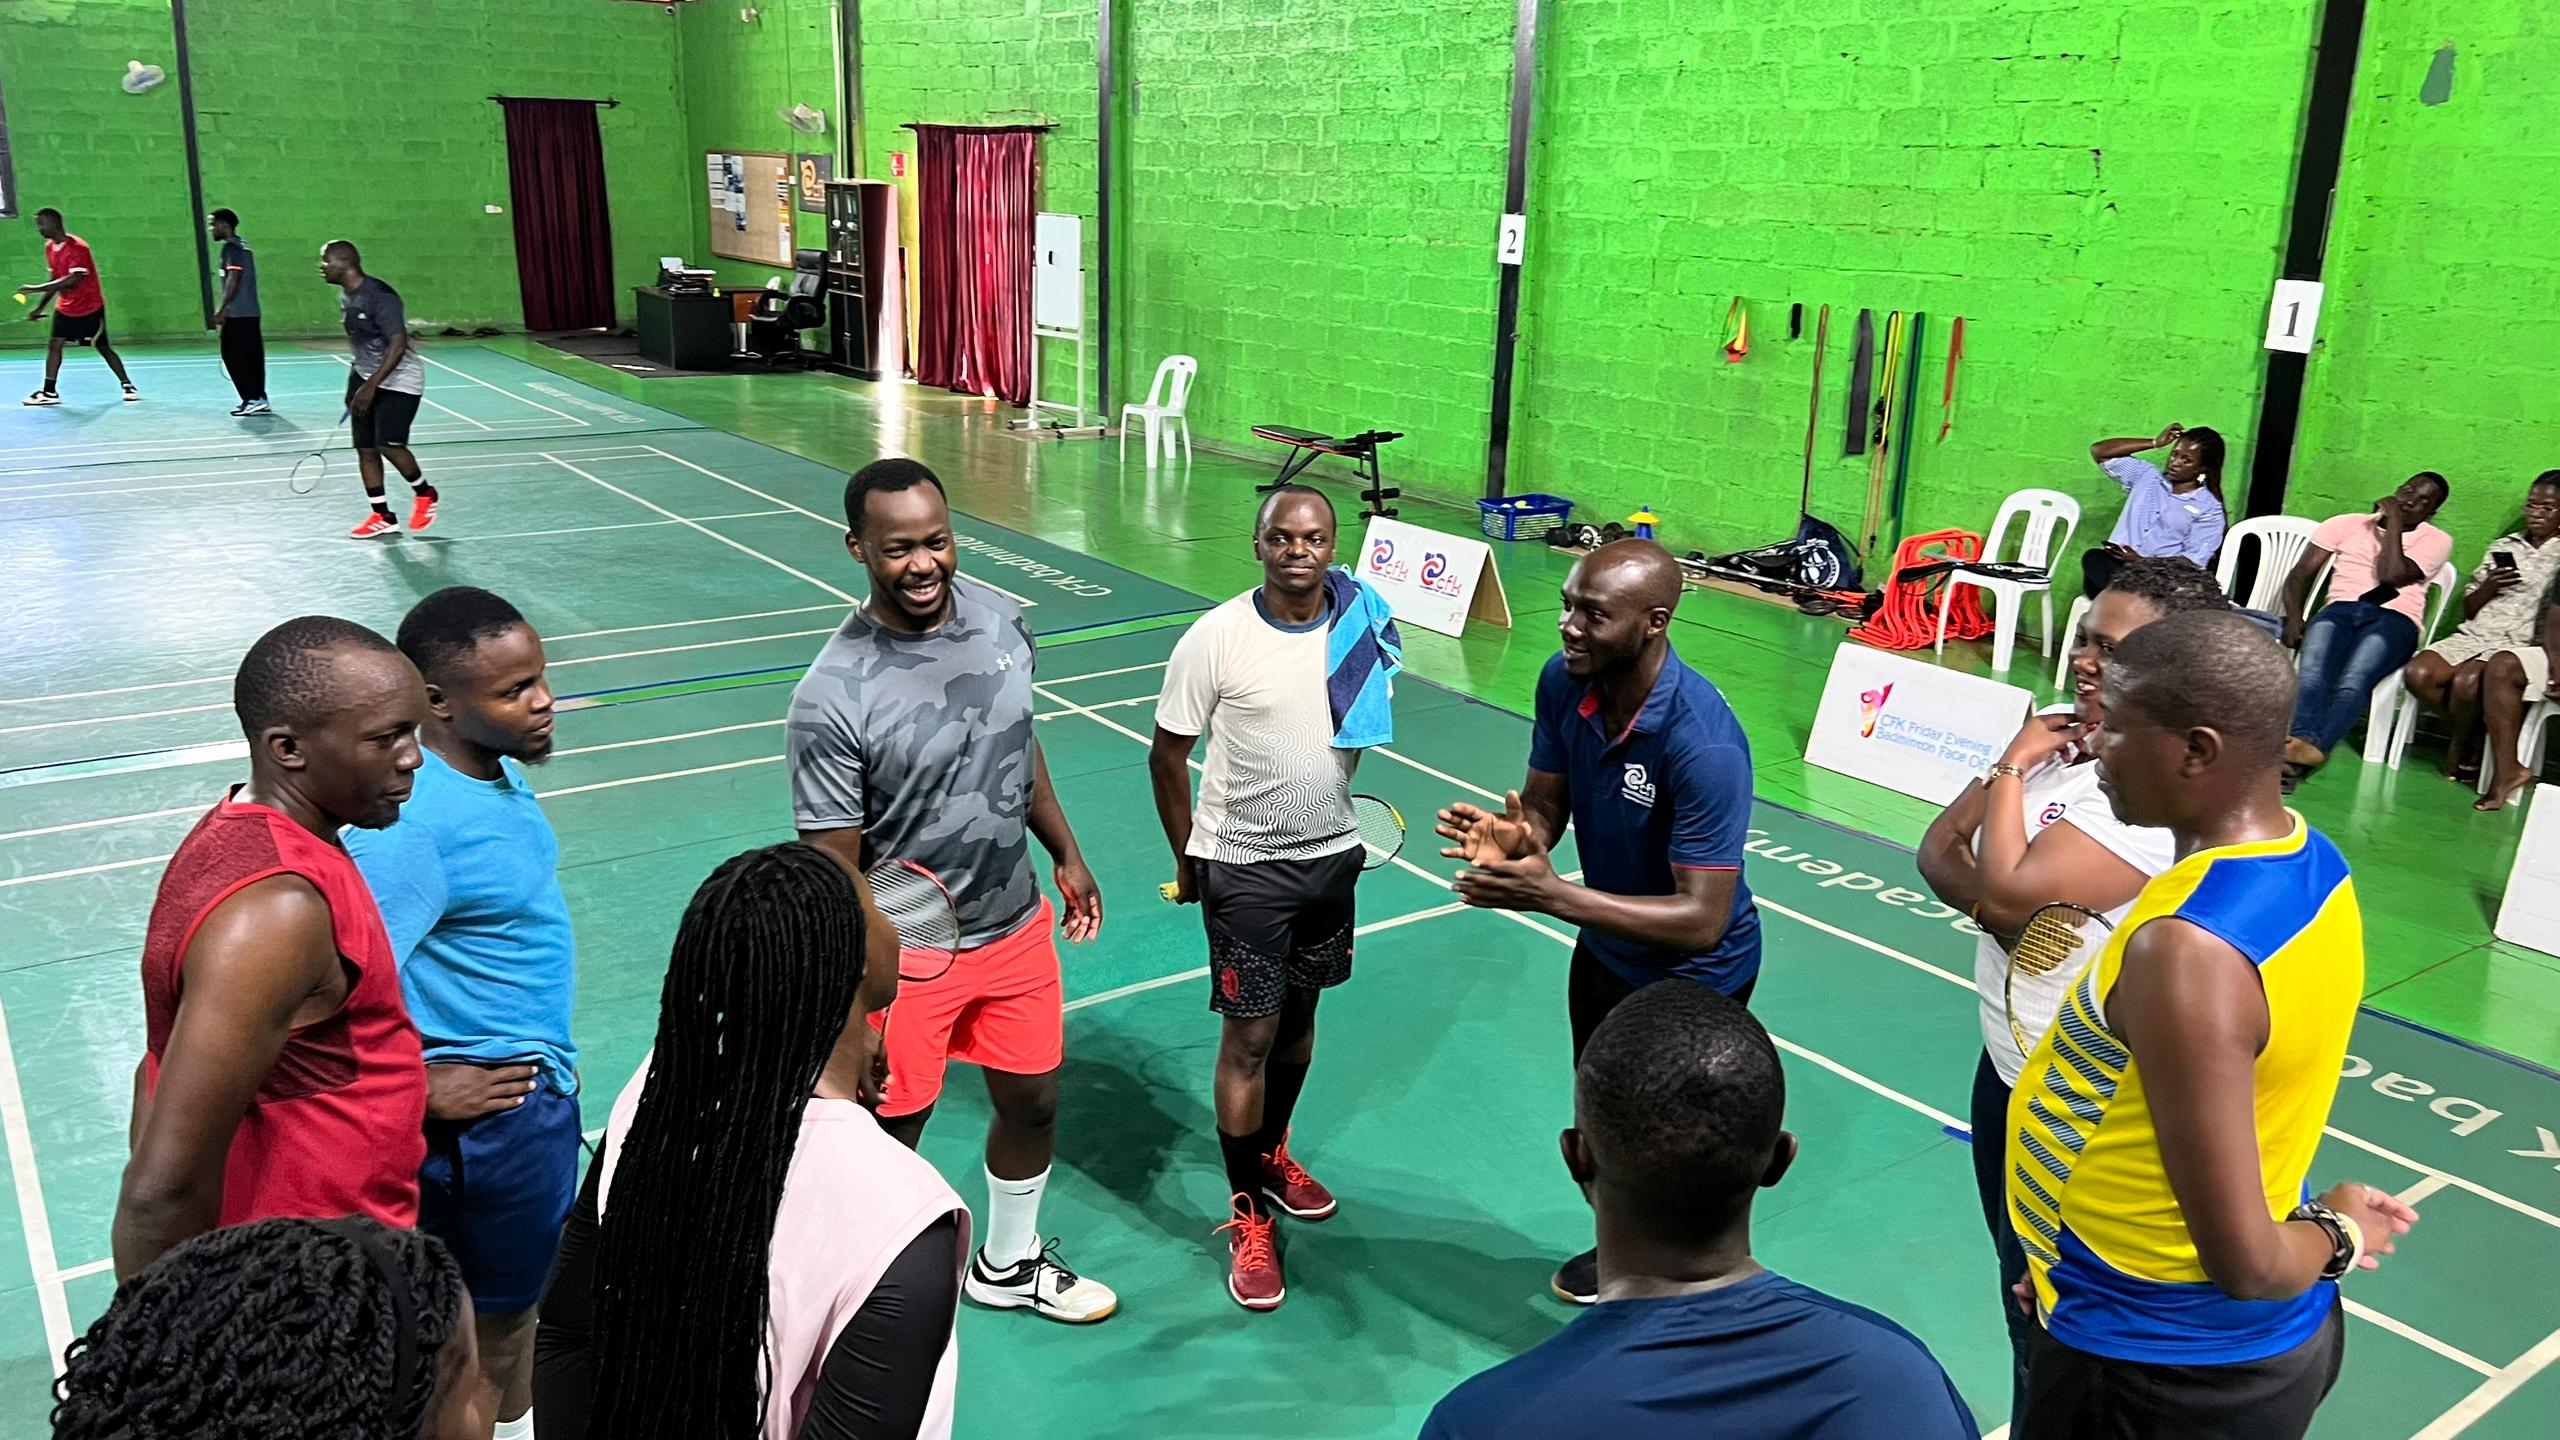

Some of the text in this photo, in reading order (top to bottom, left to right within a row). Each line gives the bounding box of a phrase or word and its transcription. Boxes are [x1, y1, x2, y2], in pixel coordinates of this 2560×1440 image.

[1506, 228, 1517, 254] 2
[2281, 301, 2301, 338] 1
[952, 531, 1113, 597] CFK badminto
[1385, 560, 1409, 579] cfk
[1437, 575, 1462, 594] cfk
[1875, 726, 1937, 753] Badminton
[1938, 745, 1967, 762] Face
[1879, 713, 1993, 756] CFK Friday Evening
